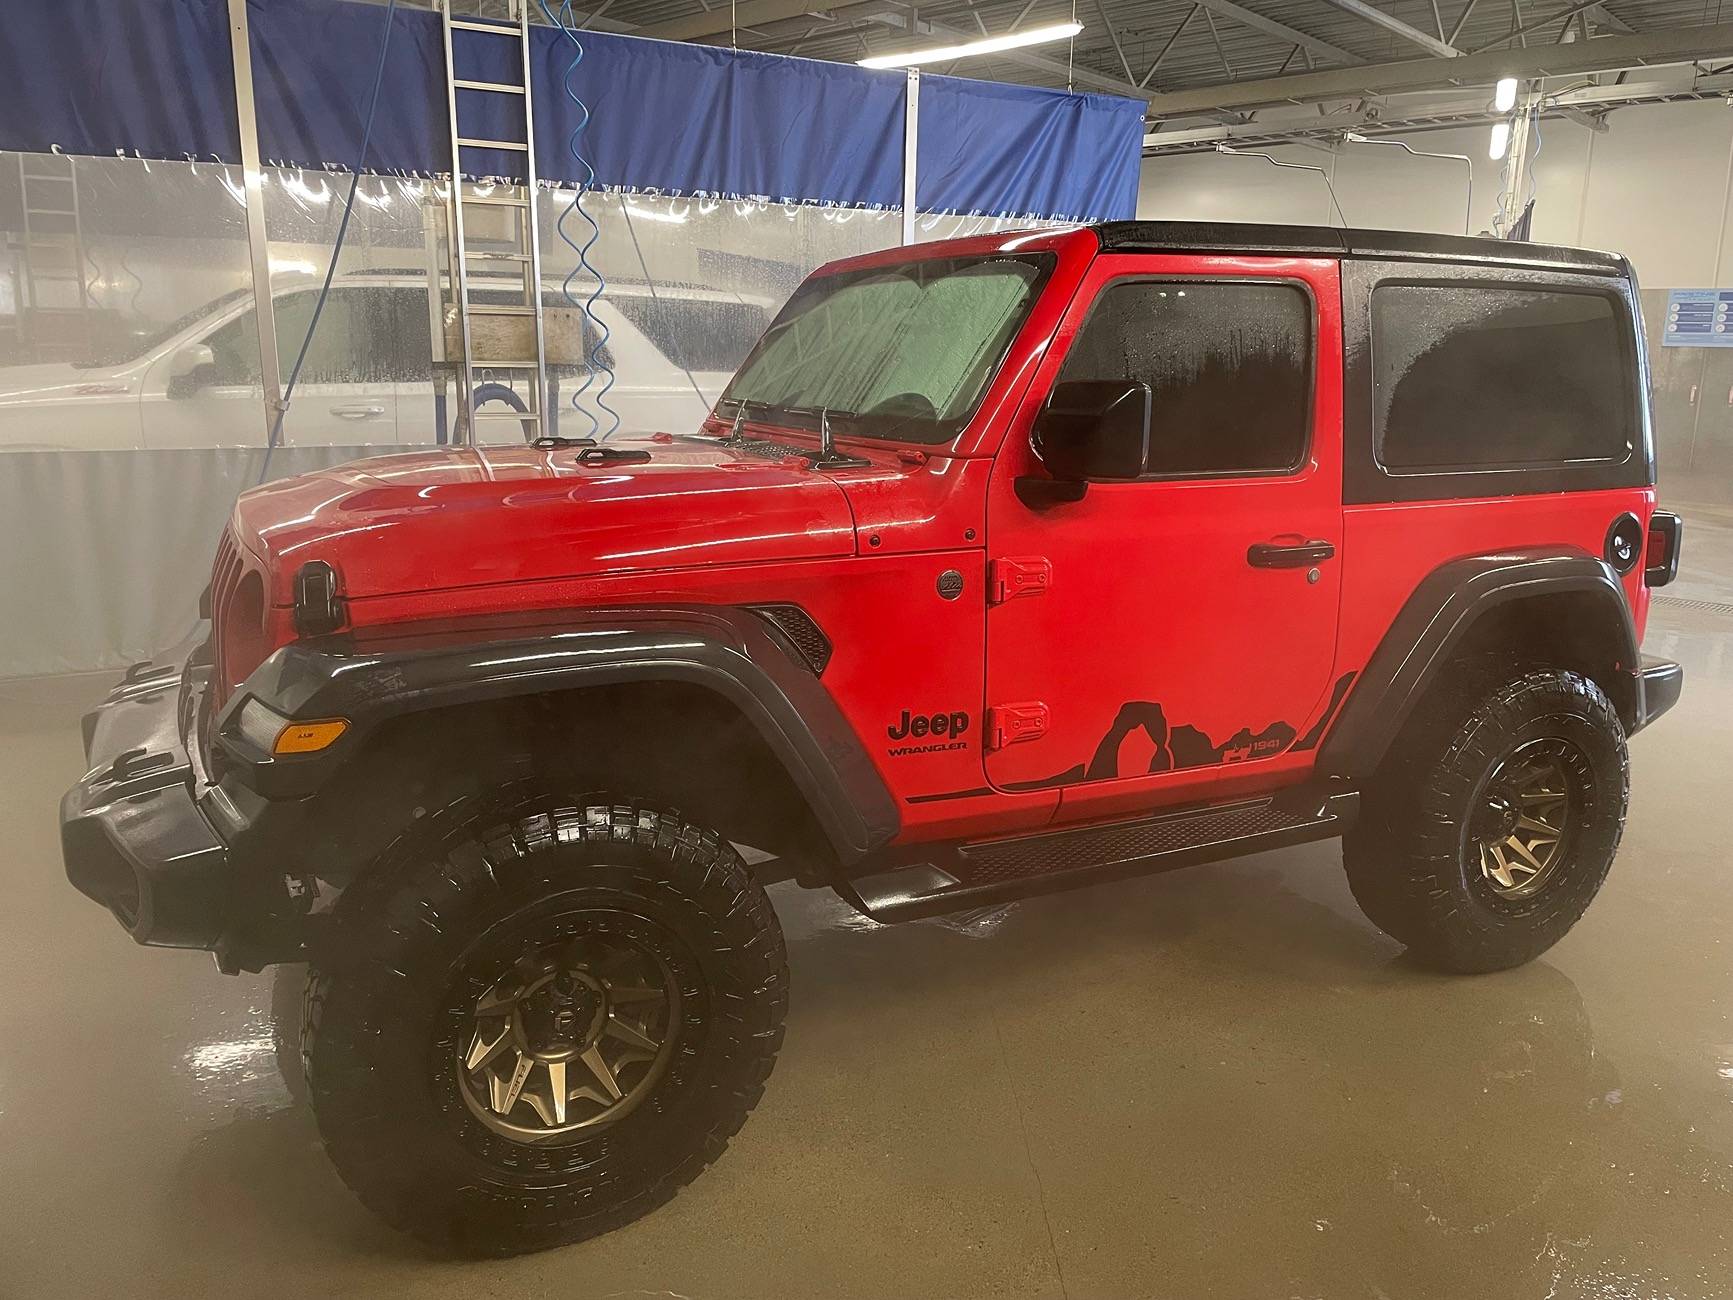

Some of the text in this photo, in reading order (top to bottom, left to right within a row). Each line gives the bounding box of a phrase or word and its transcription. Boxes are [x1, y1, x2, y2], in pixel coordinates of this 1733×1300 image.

[887, 710, 969, 740] Jeep
[888, 742, 967, 757] WRANGLER
[1253, 739, 1280, 751] 1941
